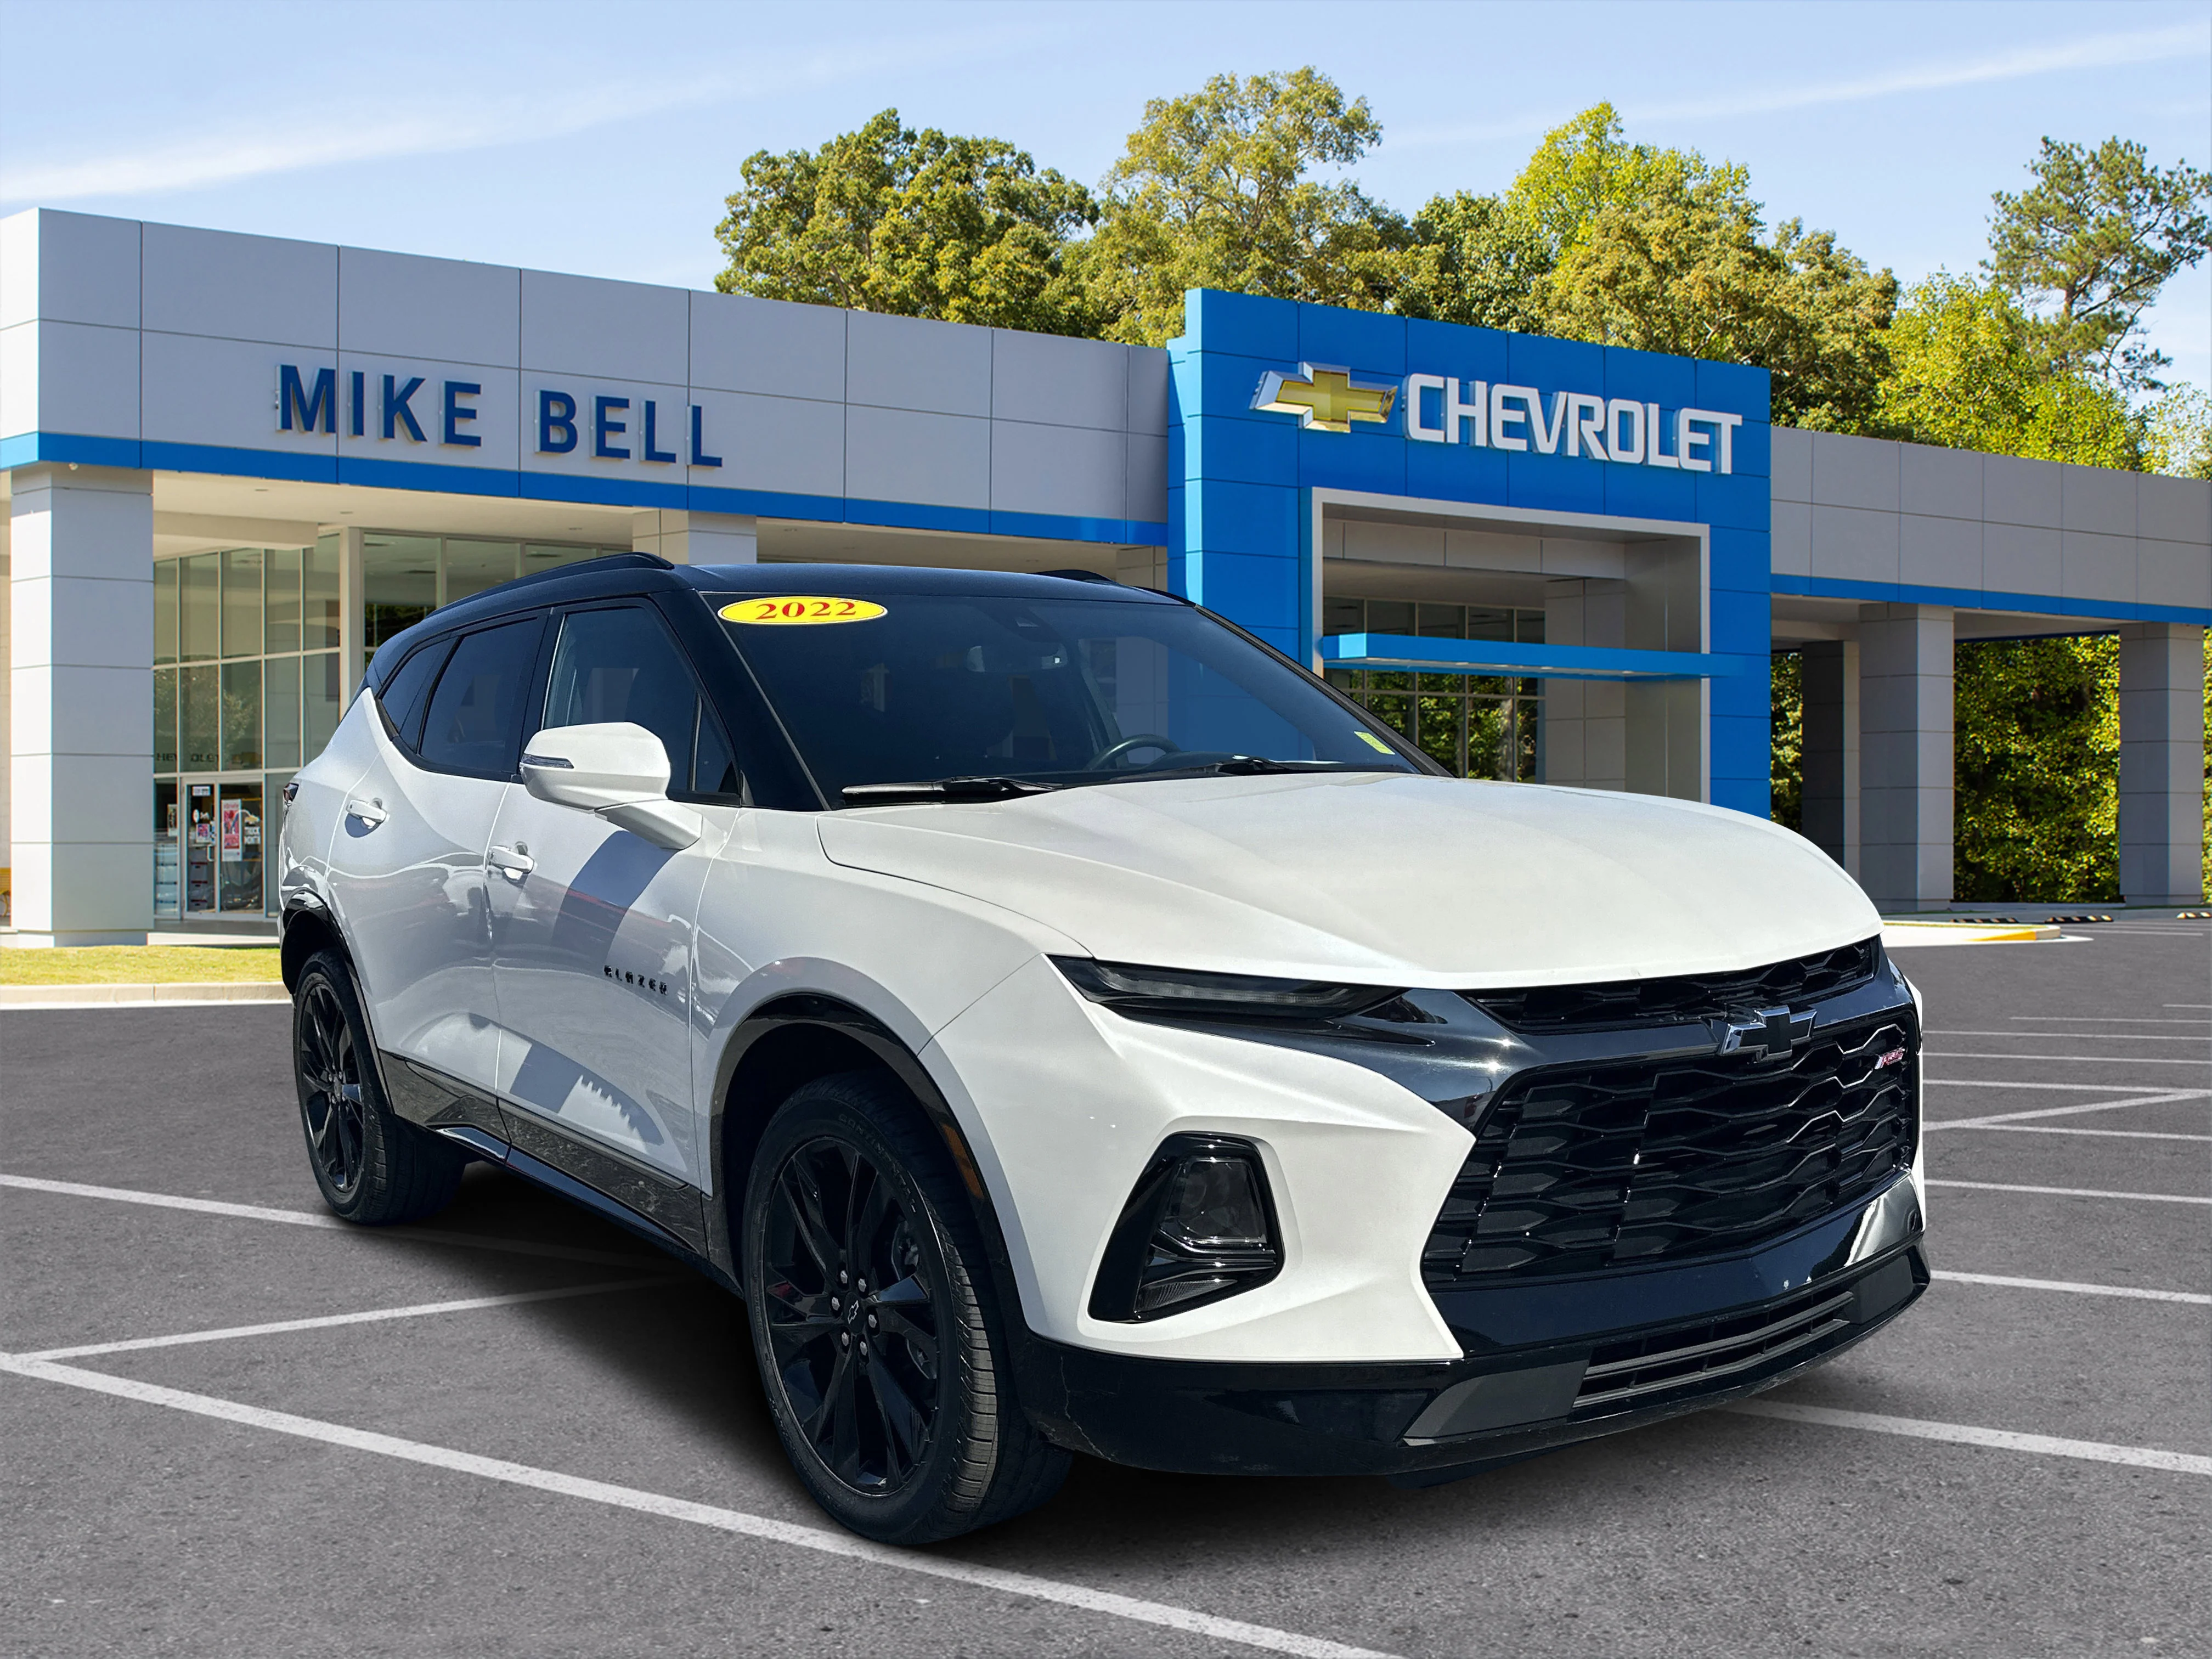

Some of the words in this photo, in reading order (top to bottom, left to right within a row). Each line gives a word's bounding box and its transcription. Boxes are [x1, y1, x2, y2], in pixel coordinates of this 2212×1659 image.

[276, 364, 482, 447] MIKE
[534, 389, 723, 468] BELL
[1402, 373, 1742, 474] CHEVROLET
[755, 601, 856, 620] 2022
[604, 964, 668, 996] BLAZER
